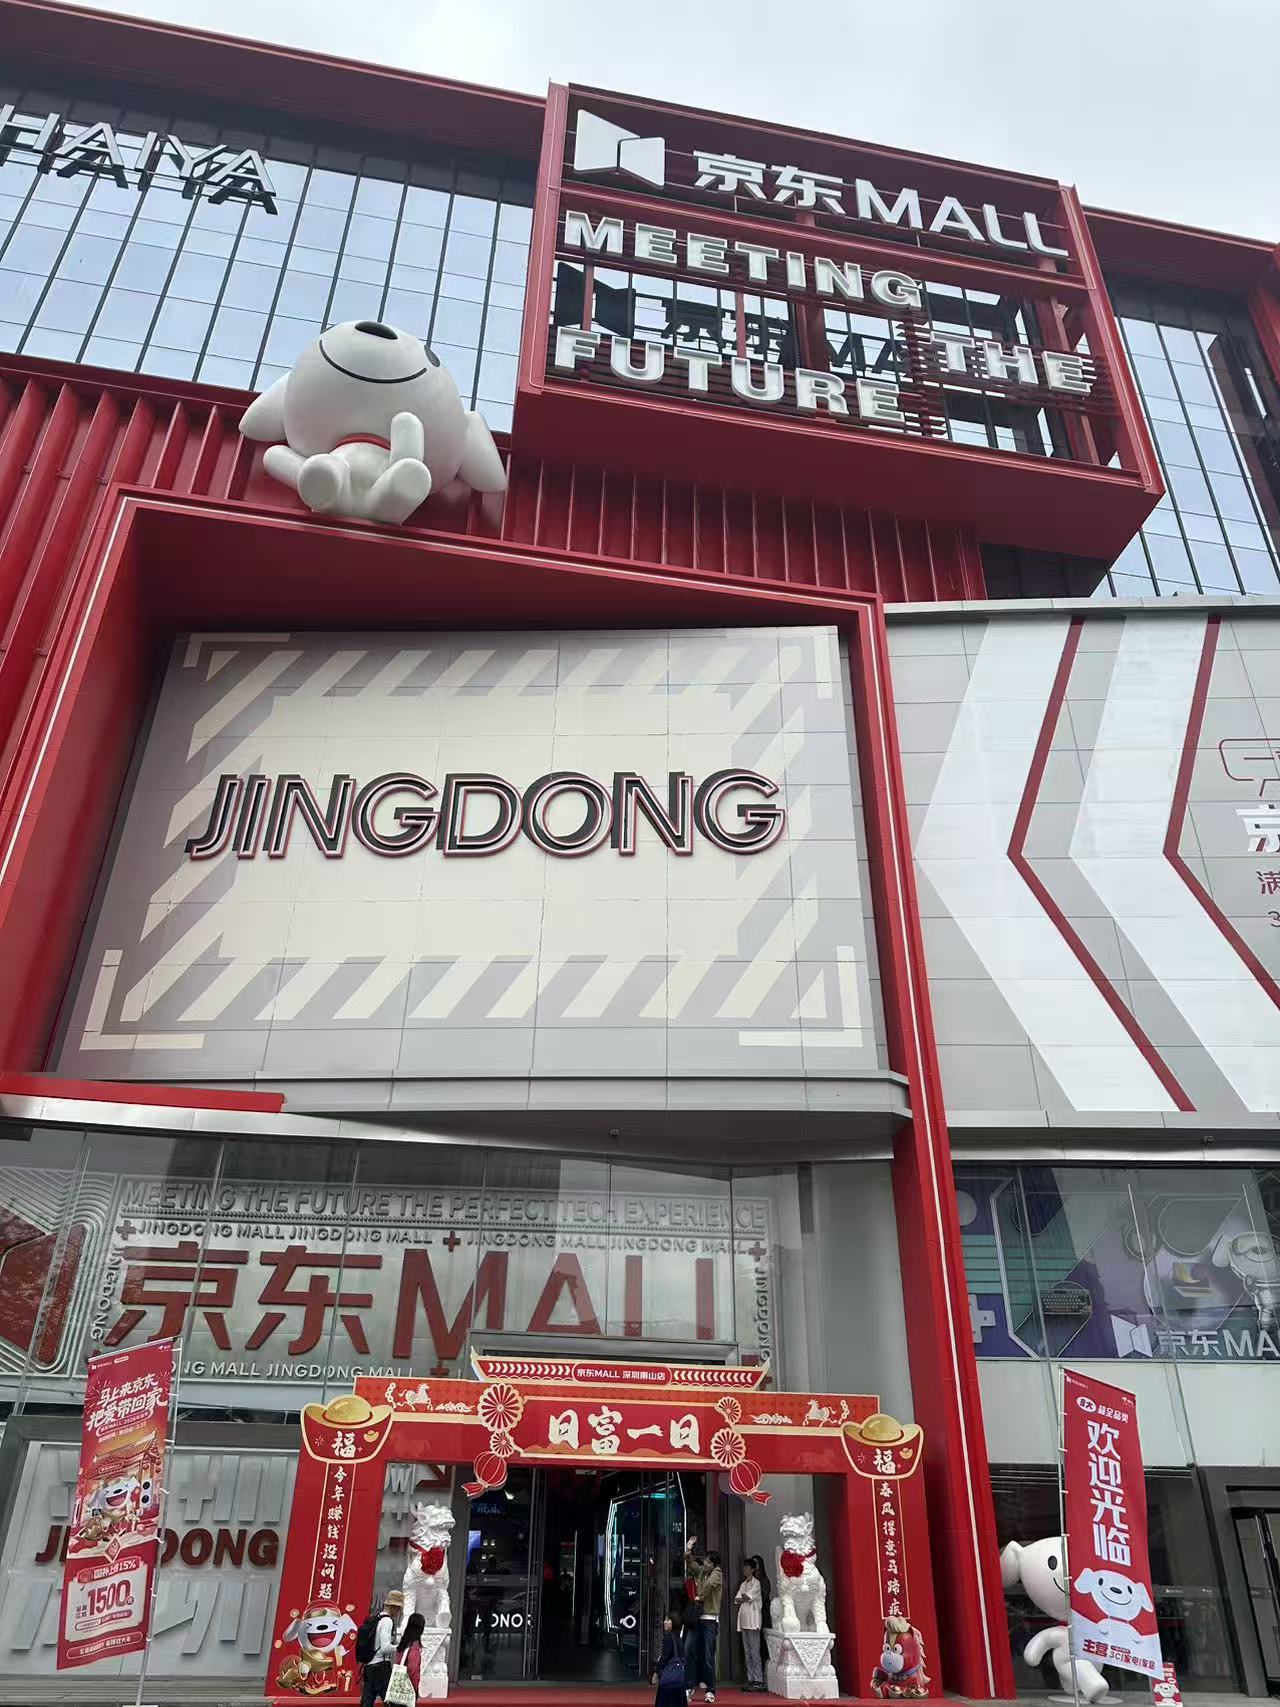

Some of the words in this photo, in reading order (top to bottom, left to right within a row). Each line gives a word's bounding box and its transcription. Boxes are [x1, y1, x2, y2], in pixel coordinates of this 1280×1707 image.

[693, 149, 1070, 258] 京东MALL
[563, 209, 924, 309] MEETING
[554, 325, 906, 424] FUTURE
[929, 330, 1092, 395] THE
[186, 771, 786, 859] JINGDONG
[122, 1180, 235, 1211] MEETING
[243, 1184, 288, 1213] THE
[294, 1185, 391, 1217] FUTURE
[398, 1191, 444, 1218] THE
[449, 1193, 557, 1222] PERFECT
[558, 1198, 618, 1225] TECH
[624, 1200, 766, 1230] EXPERIENCE
[138, 1219, 234, 1238] JINGDONG
[236, 1223, 285, 1240] MALL
[289, 1224, 383, 1243] JINGDONG
[386, 1229, 433, 1245] MALL
[467, 1231, 557, 1248] JINGDONG
[560, 1233, 607, 1250] MALL
[609, 1236, 698, 1254] JINGDONG
[701, 1239, 749, 1256] MALL
[97, 1372, 159, 1408] 马上来京东
[209, 1361, 261, 1378] MALL
[265, 1362, 364, 1380] JINGDONG
[576, 1367, 621, 1379] 京东MALL
[86, 1386, 168, 1432] 把爱带回家
[331, 1430, 357, 1459] 福
[872, 1447, 897, 1475] 福
[1087, 1419, 1132, 1567] 欢迎光临
[317, 1465, 348, 1600] 今年赚钱没问题
[879, 1481, 903, 1617] 春风得意马蹄疾
[1082, 1638, 1109, 1658] 主营
